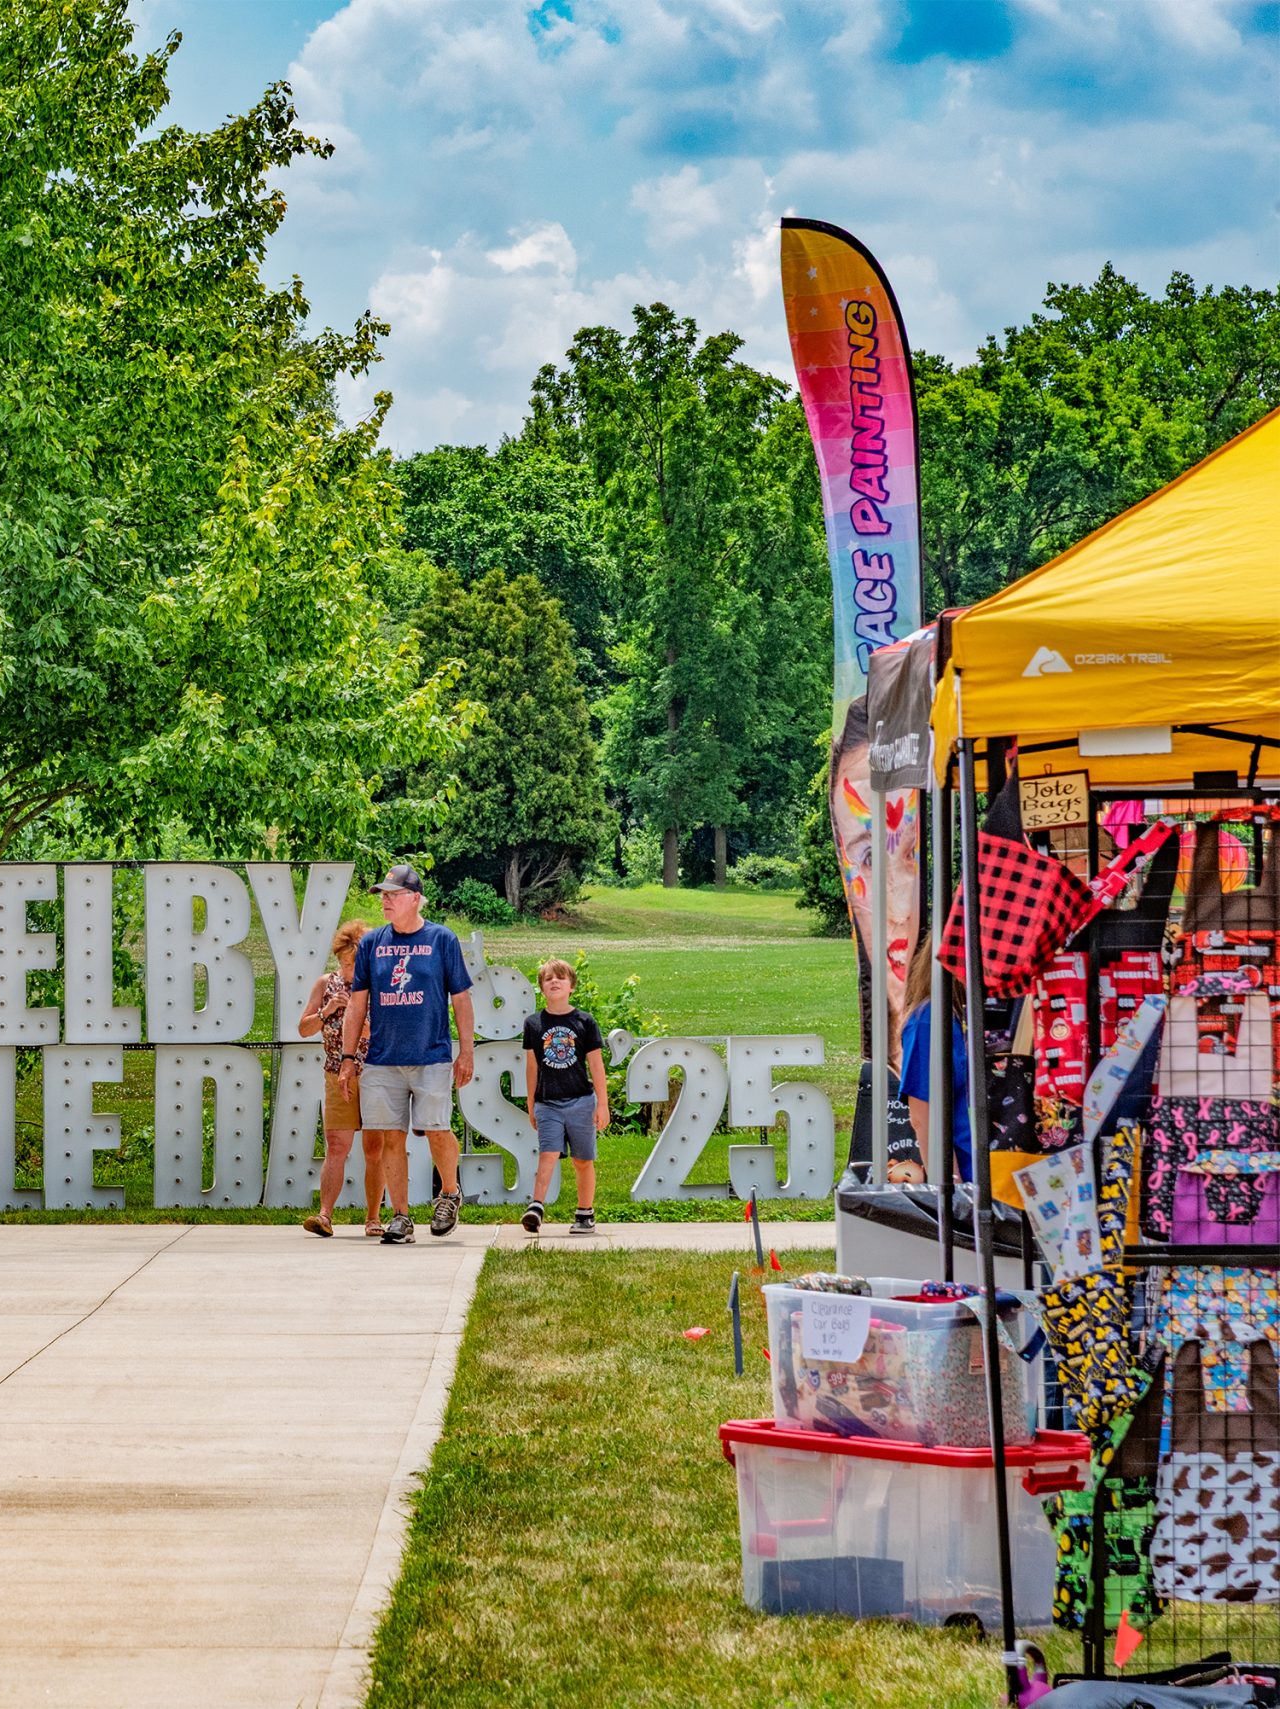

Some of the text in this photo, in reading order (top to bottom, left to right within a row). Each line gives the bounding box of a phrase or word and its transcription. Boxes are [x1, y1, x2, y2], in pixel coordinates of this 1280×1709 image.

[844, 299, 892, 536] PAINTING
[1023, 780, 1077, 800] Tote
[1023, 796, 1082, 813] Bags
[1026, 811, 1080, 827] $20
[375, 945, 433, 958] CLEVELAND
[379, 991, 424, 1006] INDIANS
[542, 1057, 568, 1069] PLAYING
[154, 1041, 561, 1211] DAS
[811, 1301, 853, 1317] Clearance
